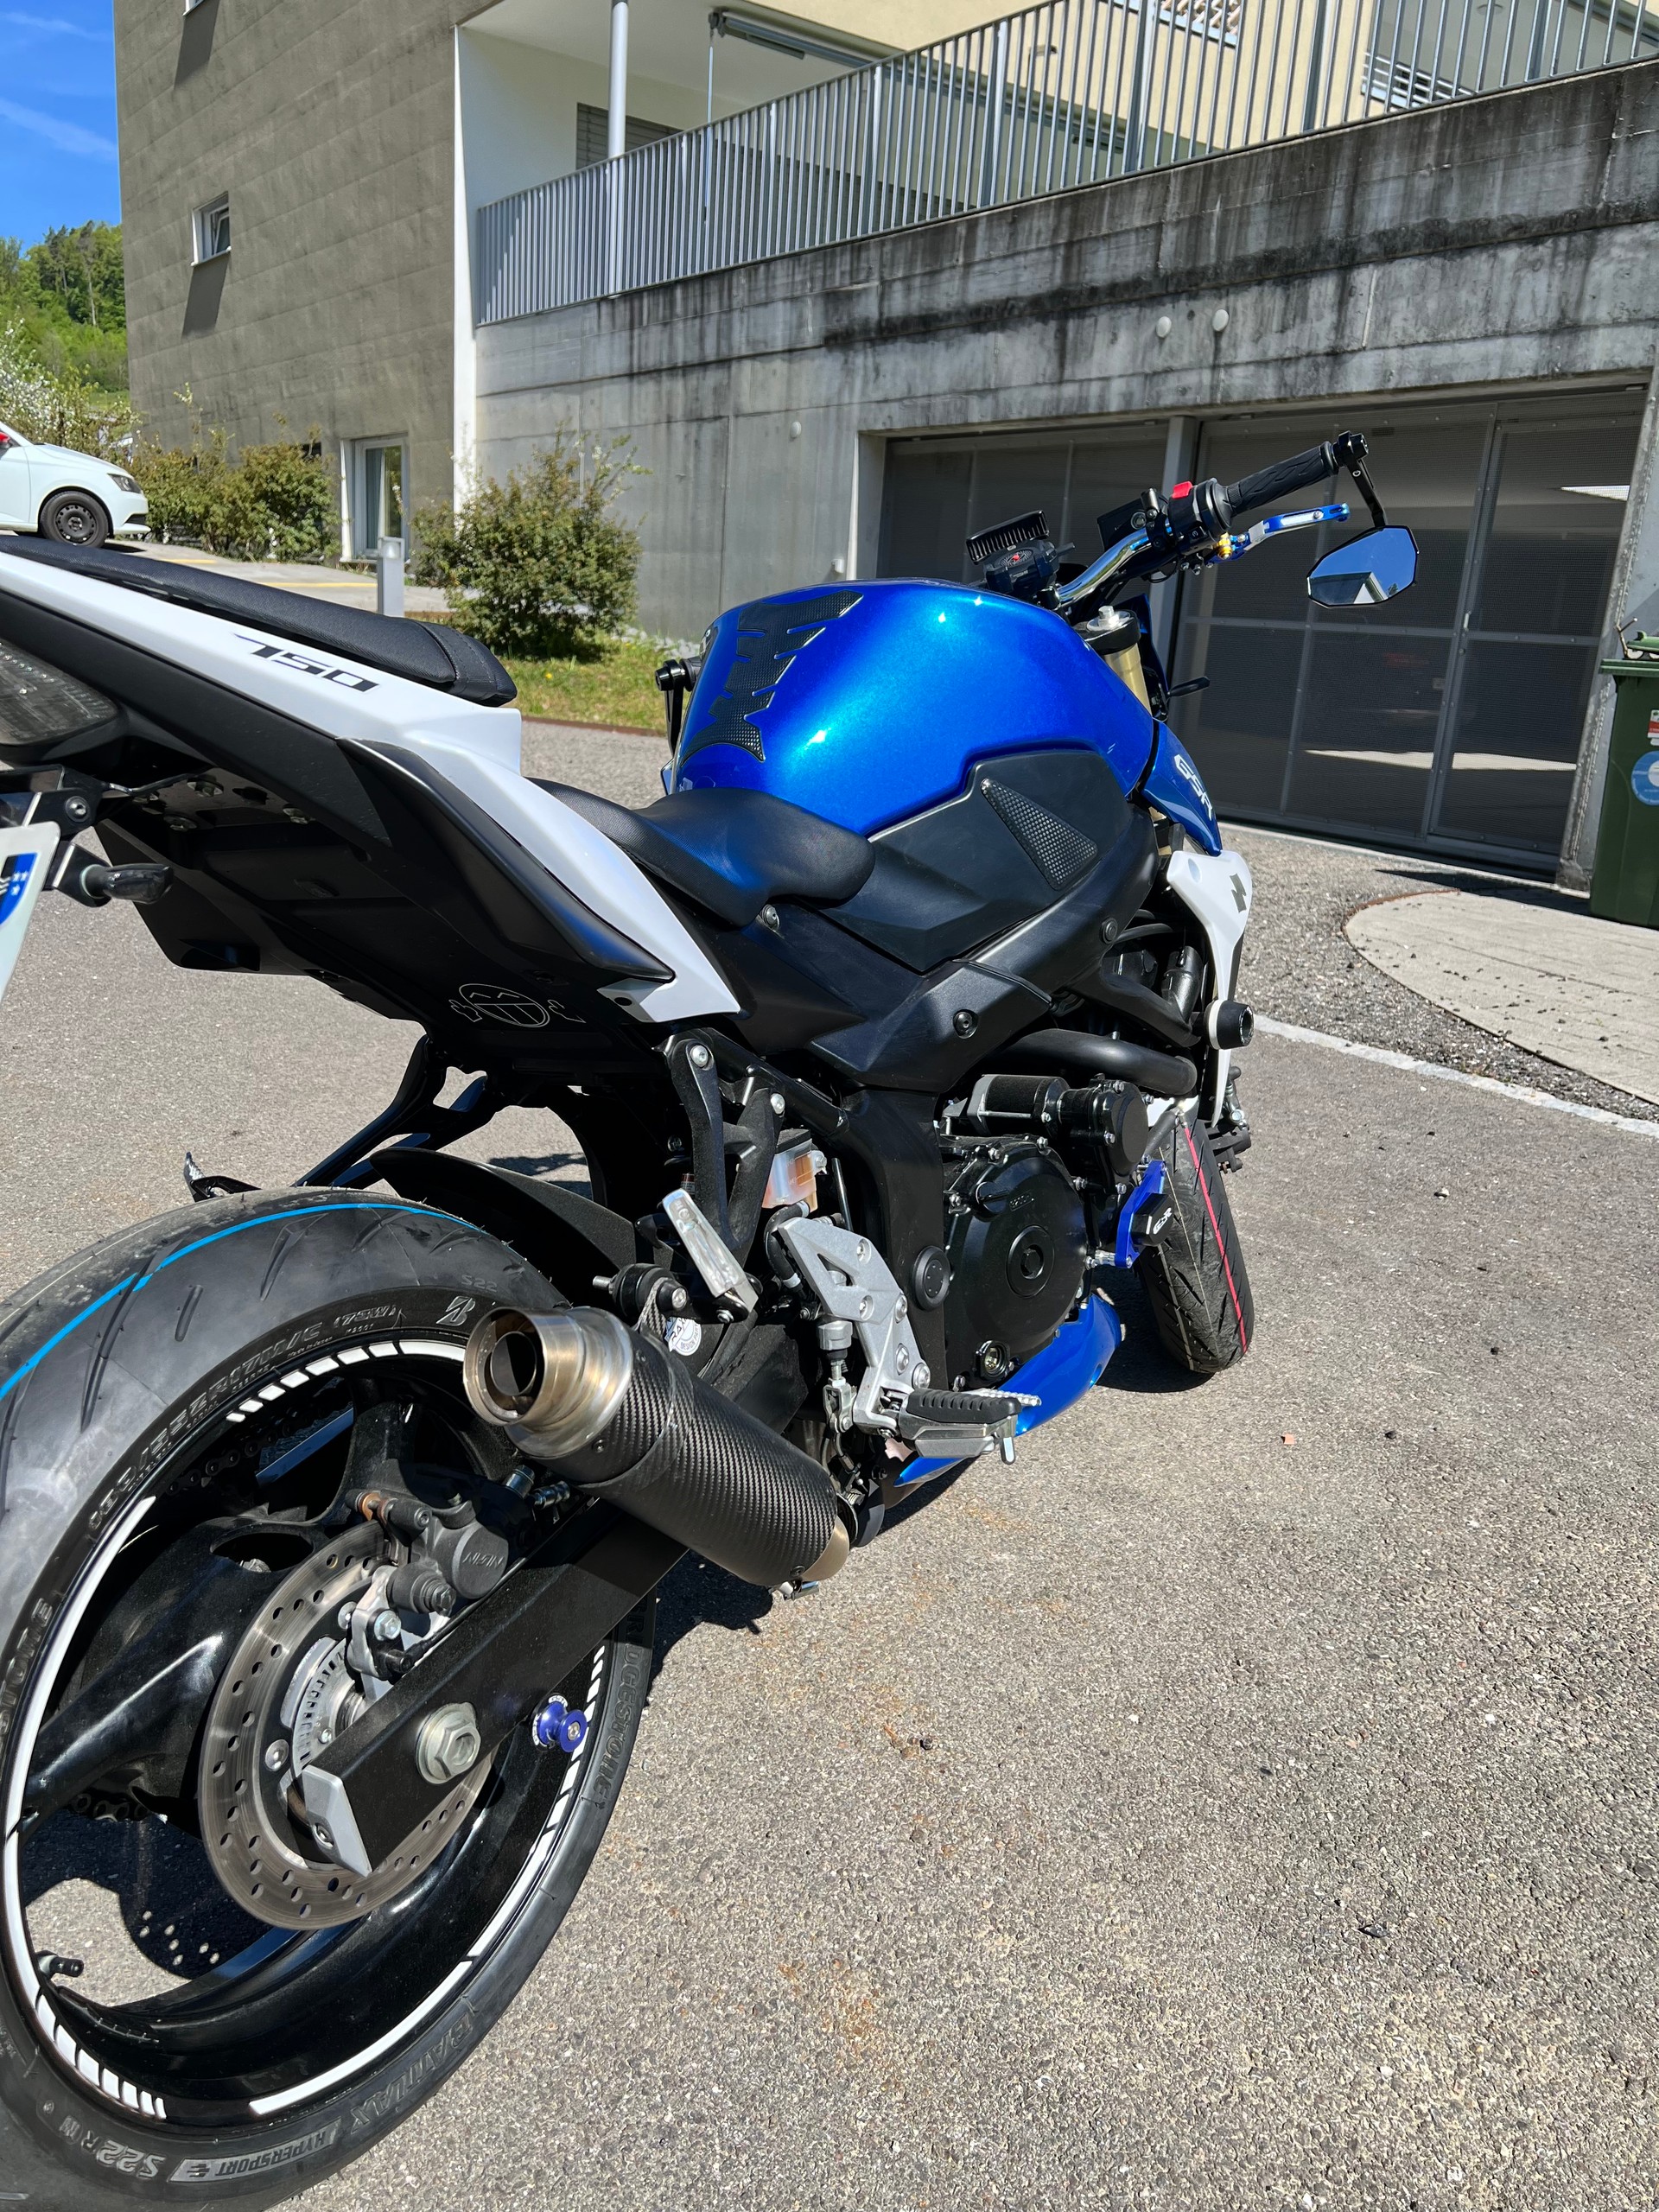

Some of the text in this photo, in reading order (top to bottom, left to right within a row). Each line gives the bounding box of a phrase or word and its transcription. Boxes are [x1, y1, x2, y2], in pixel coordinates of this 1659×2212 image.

[234, 633, 380, 693] 750
[1173, 753, 1213, 821] GSR
[461, 1274, 498, 1293] S22
[215, 2131, 327, 2177] HYPERSPORT
